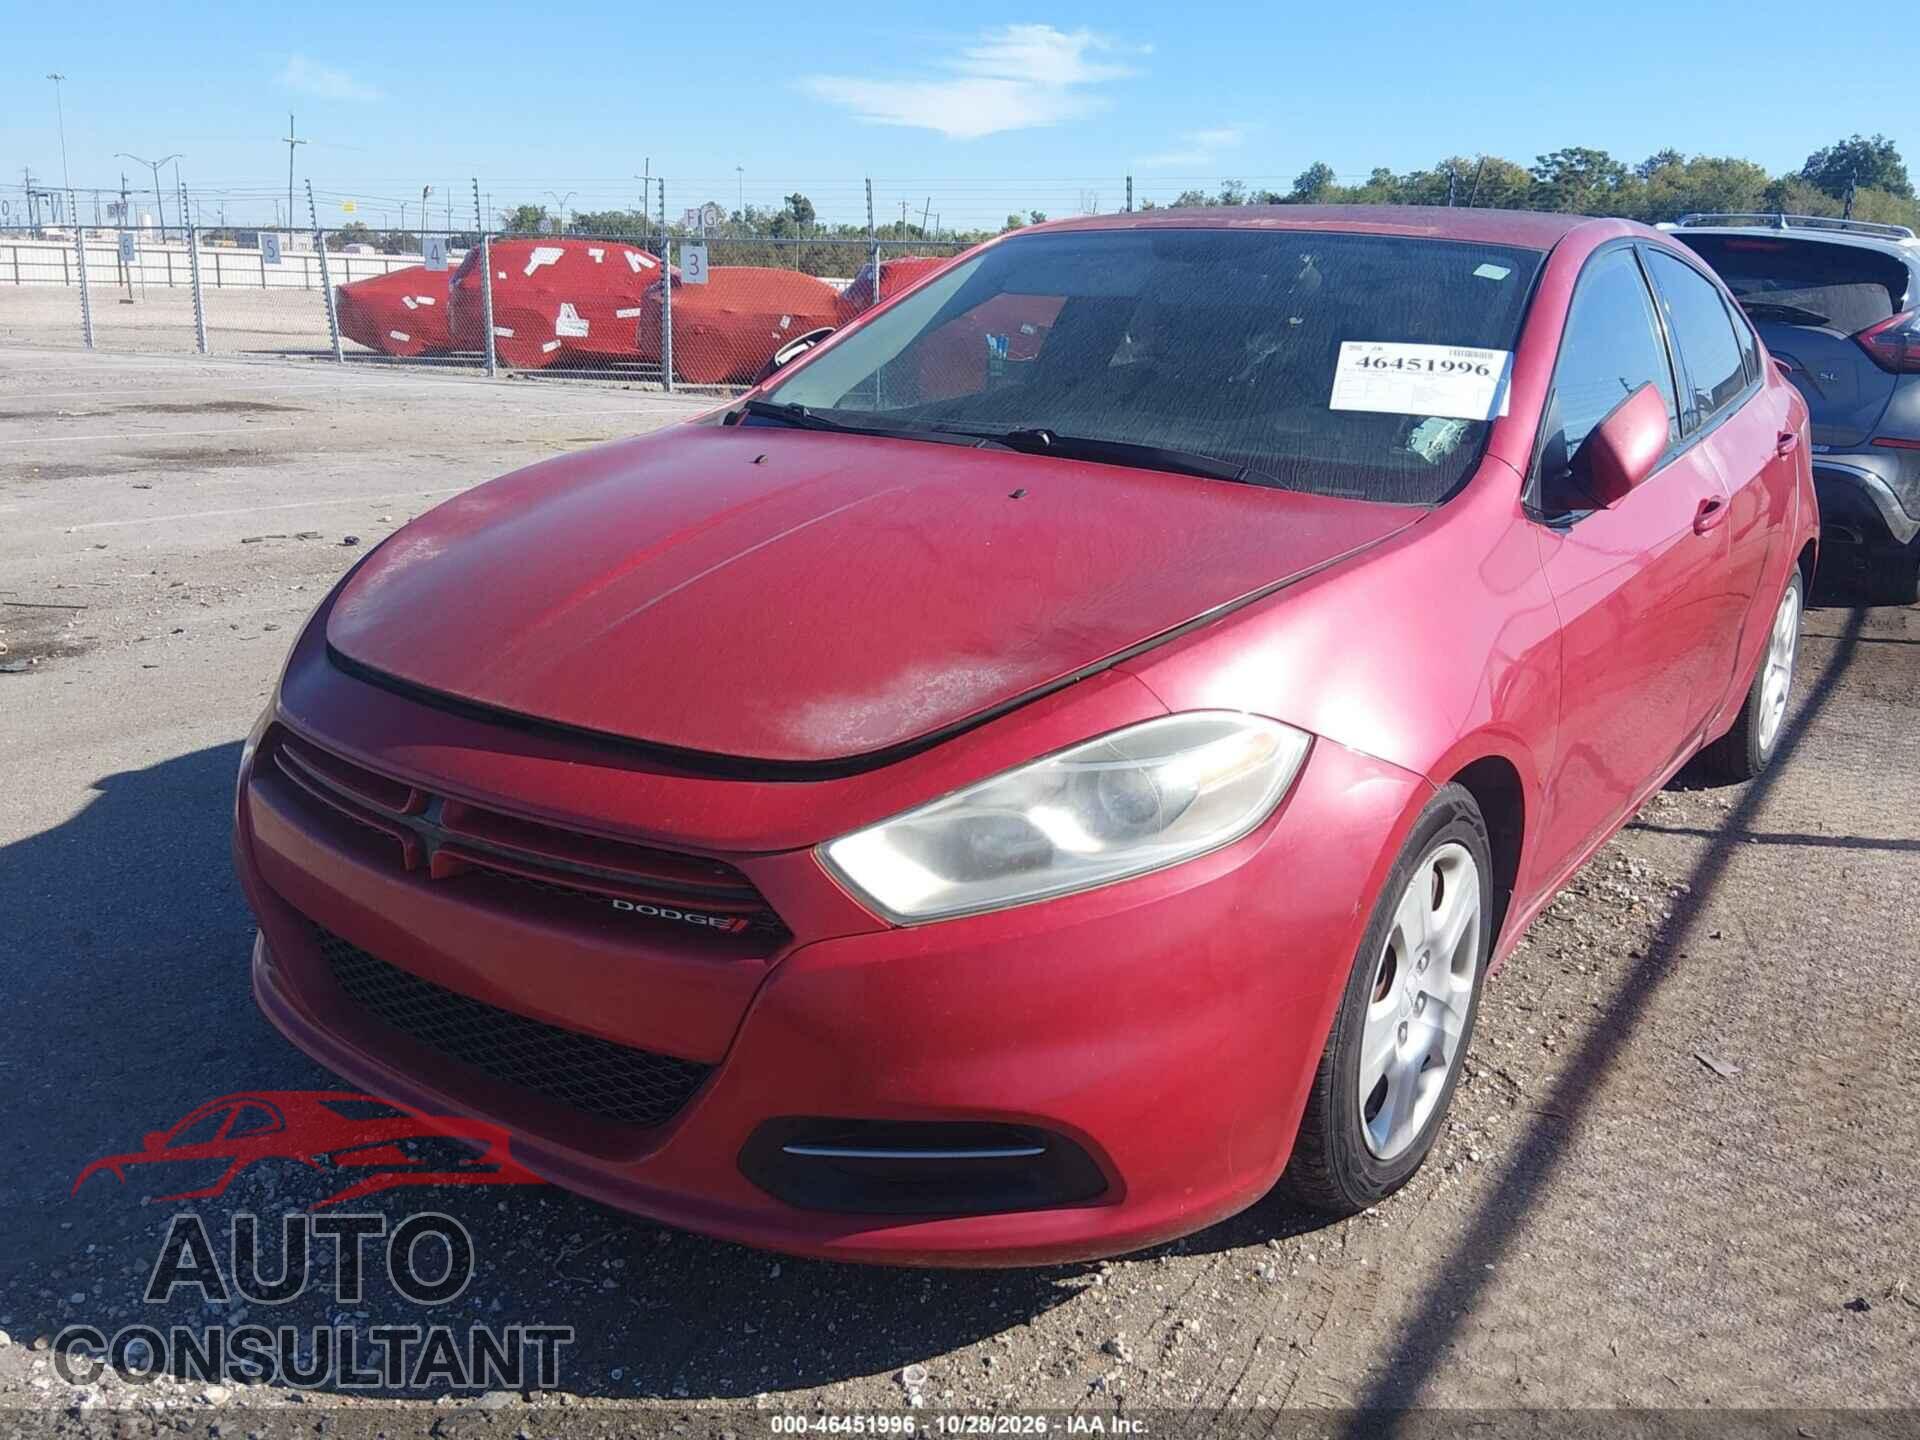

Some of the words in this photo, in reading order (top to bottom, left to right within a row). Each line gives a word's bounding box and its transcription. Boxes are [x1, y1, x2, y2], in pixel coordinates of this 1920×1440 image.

[431, 243, 440, 264] 4
[688, 253, 700, 276] 3
[1354, 355, 1491, 377] 46451996
[611, 898, 731, 929] DODGE
